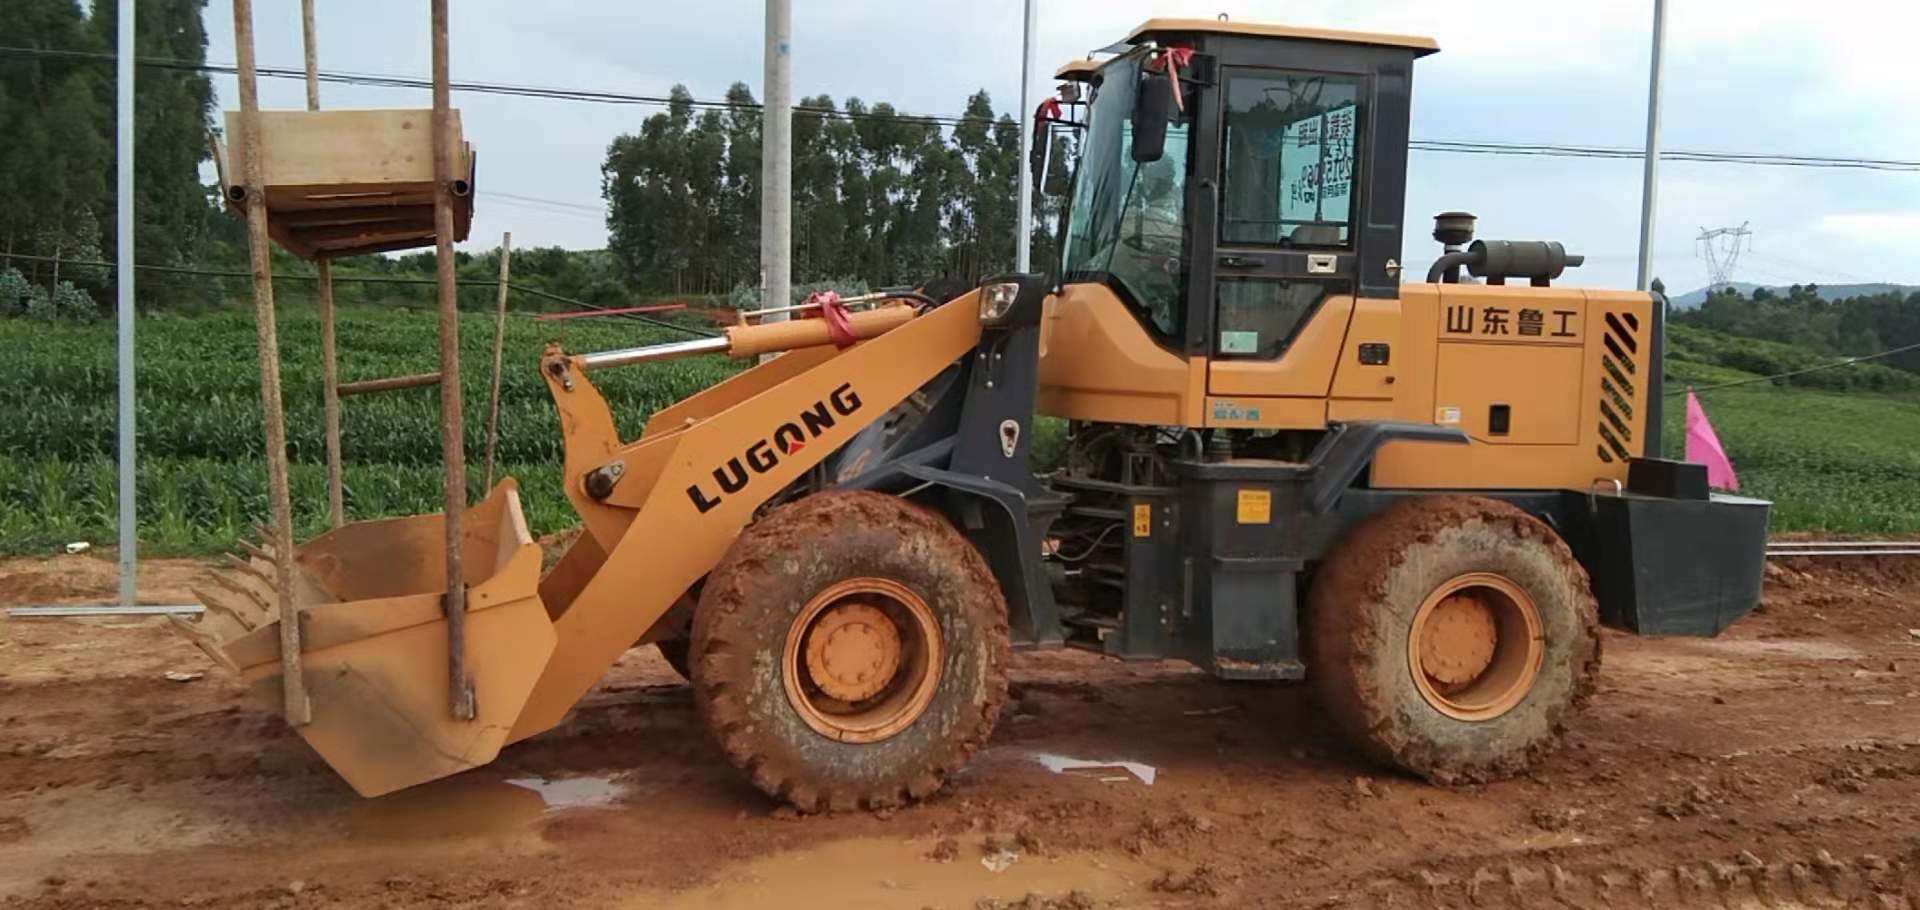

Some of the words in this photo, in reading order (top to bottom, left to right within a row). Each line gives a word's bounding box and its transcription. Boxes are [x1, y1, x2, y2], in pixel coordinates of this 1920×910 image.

[1446, 305, 1578, 338] 山东鲁工
[686, 382, 863, 514] LUGONG
